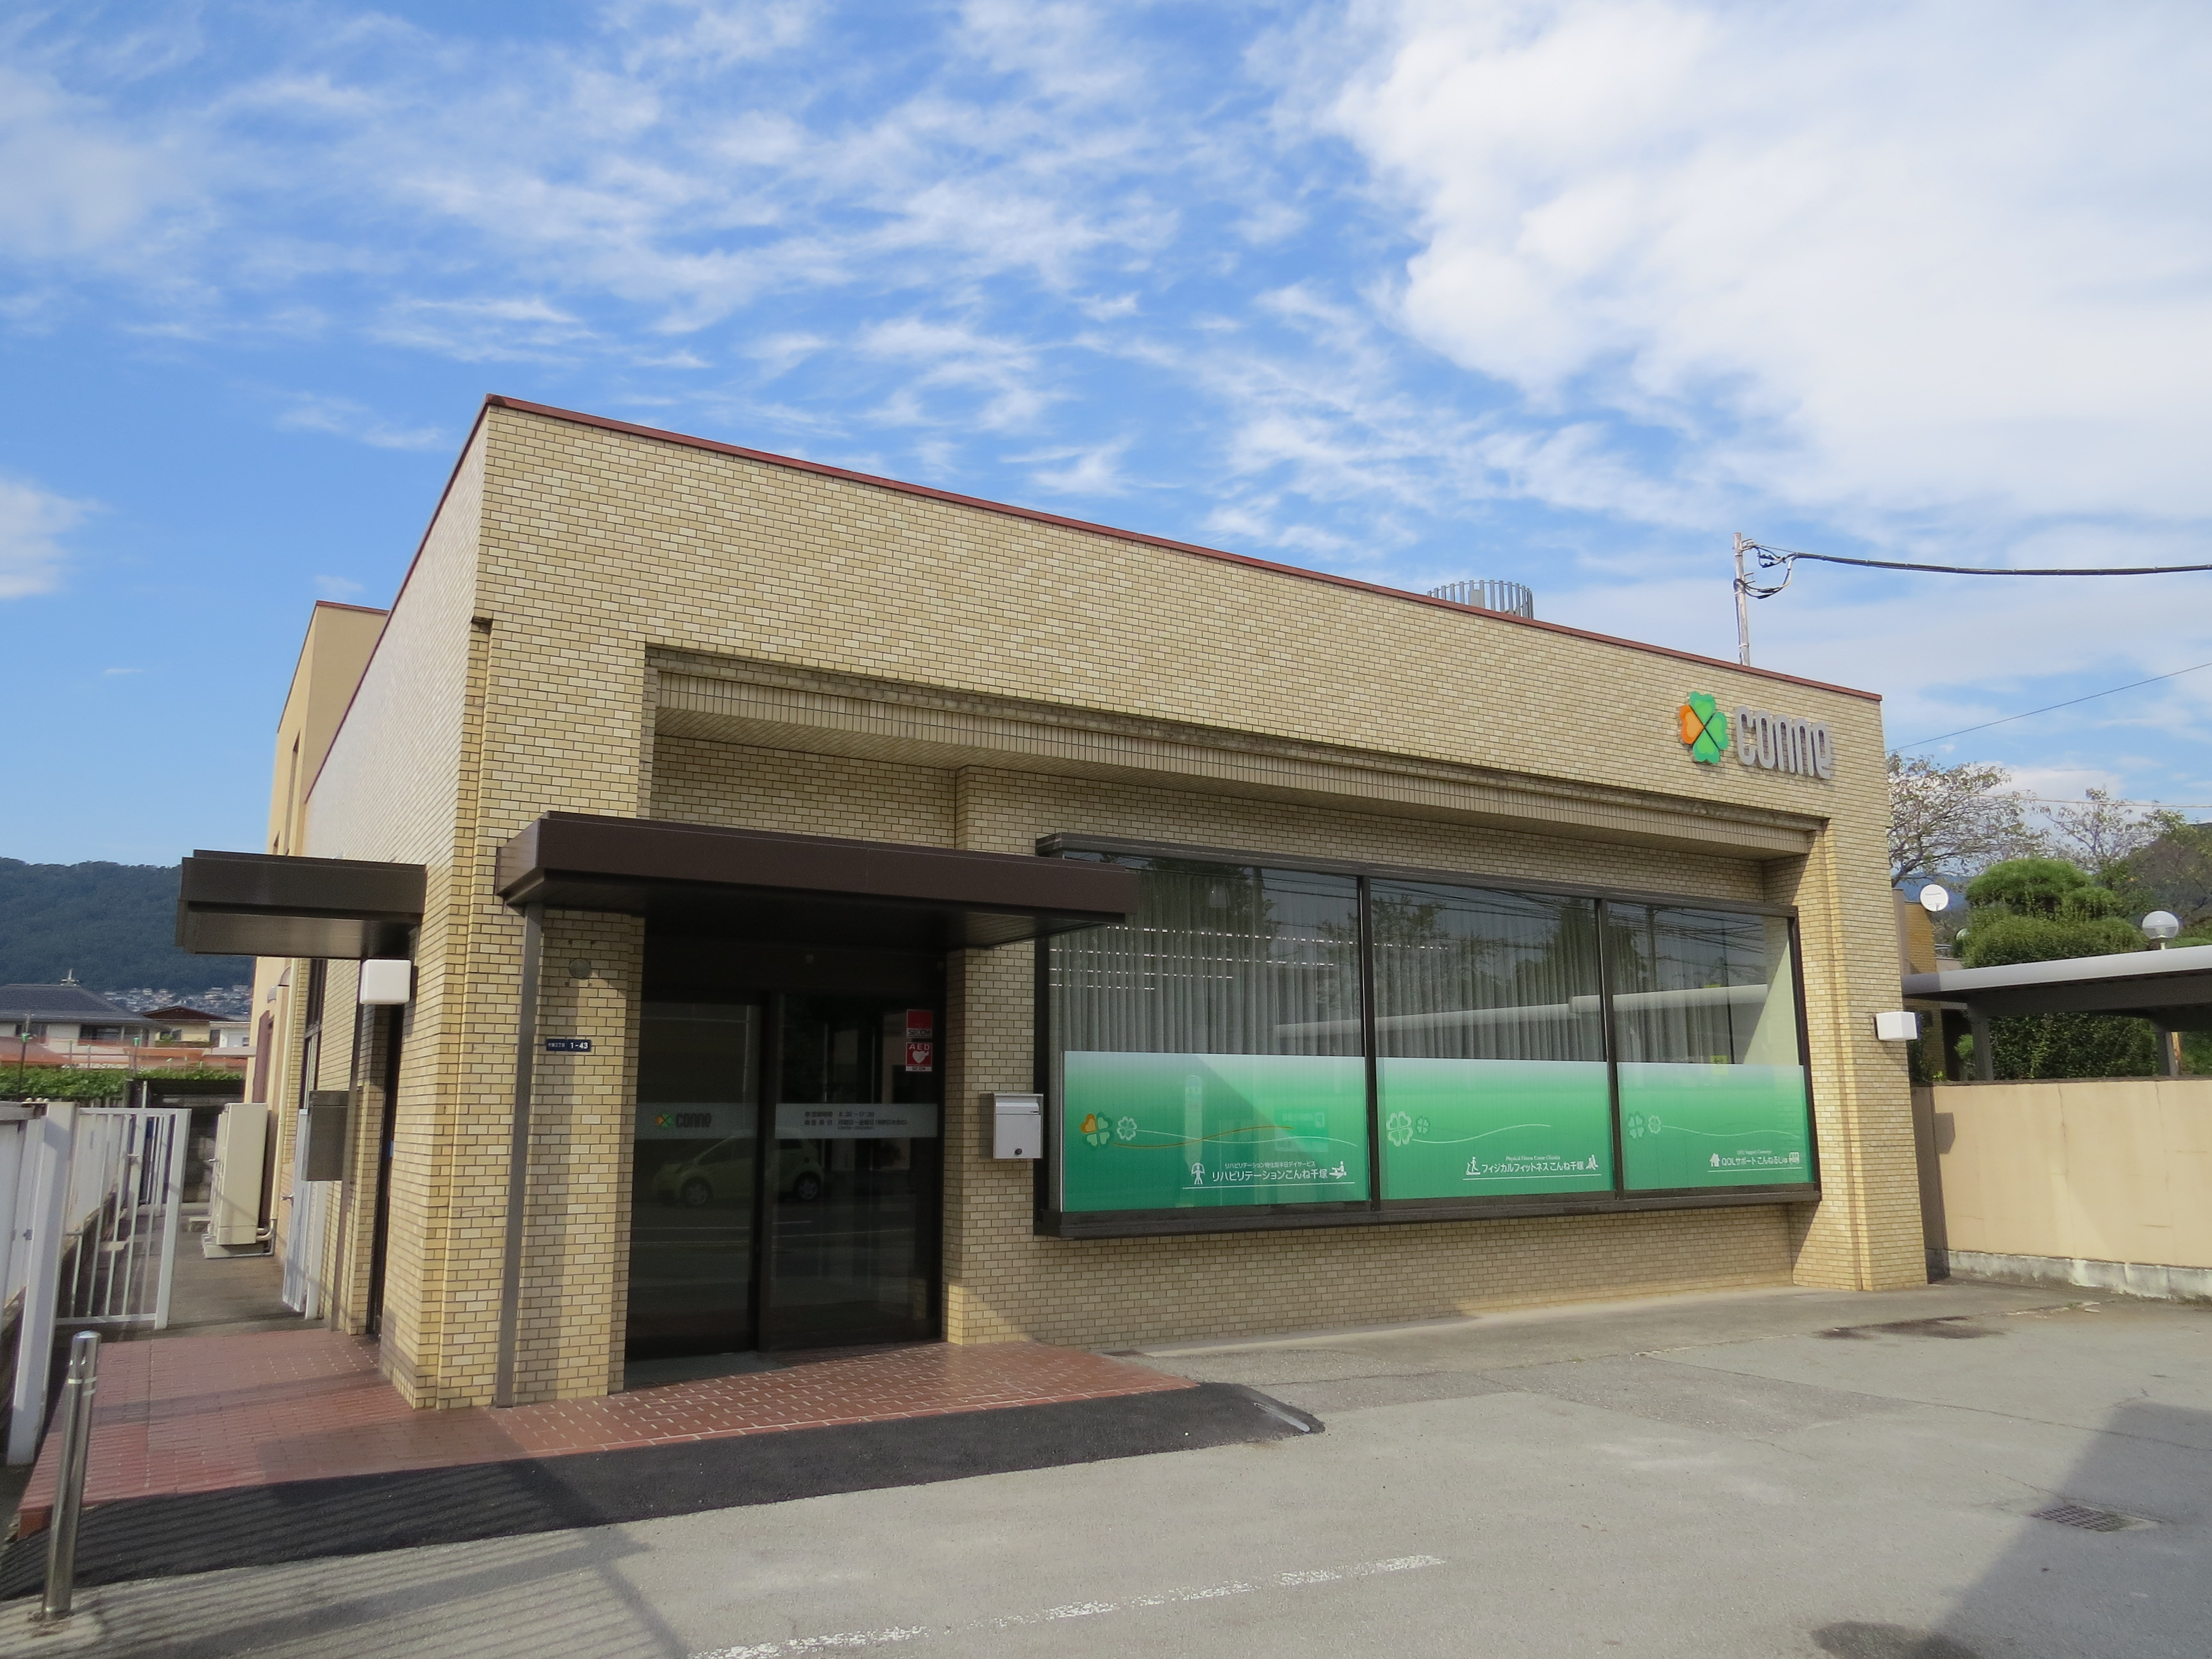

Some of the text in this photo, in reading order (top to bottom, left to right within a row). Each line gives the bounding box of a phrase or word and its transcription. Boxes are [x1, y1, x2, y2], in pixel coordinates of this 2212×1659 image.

[1212, 1168, 1328, 1182] リハビリテーションこんね千塚
